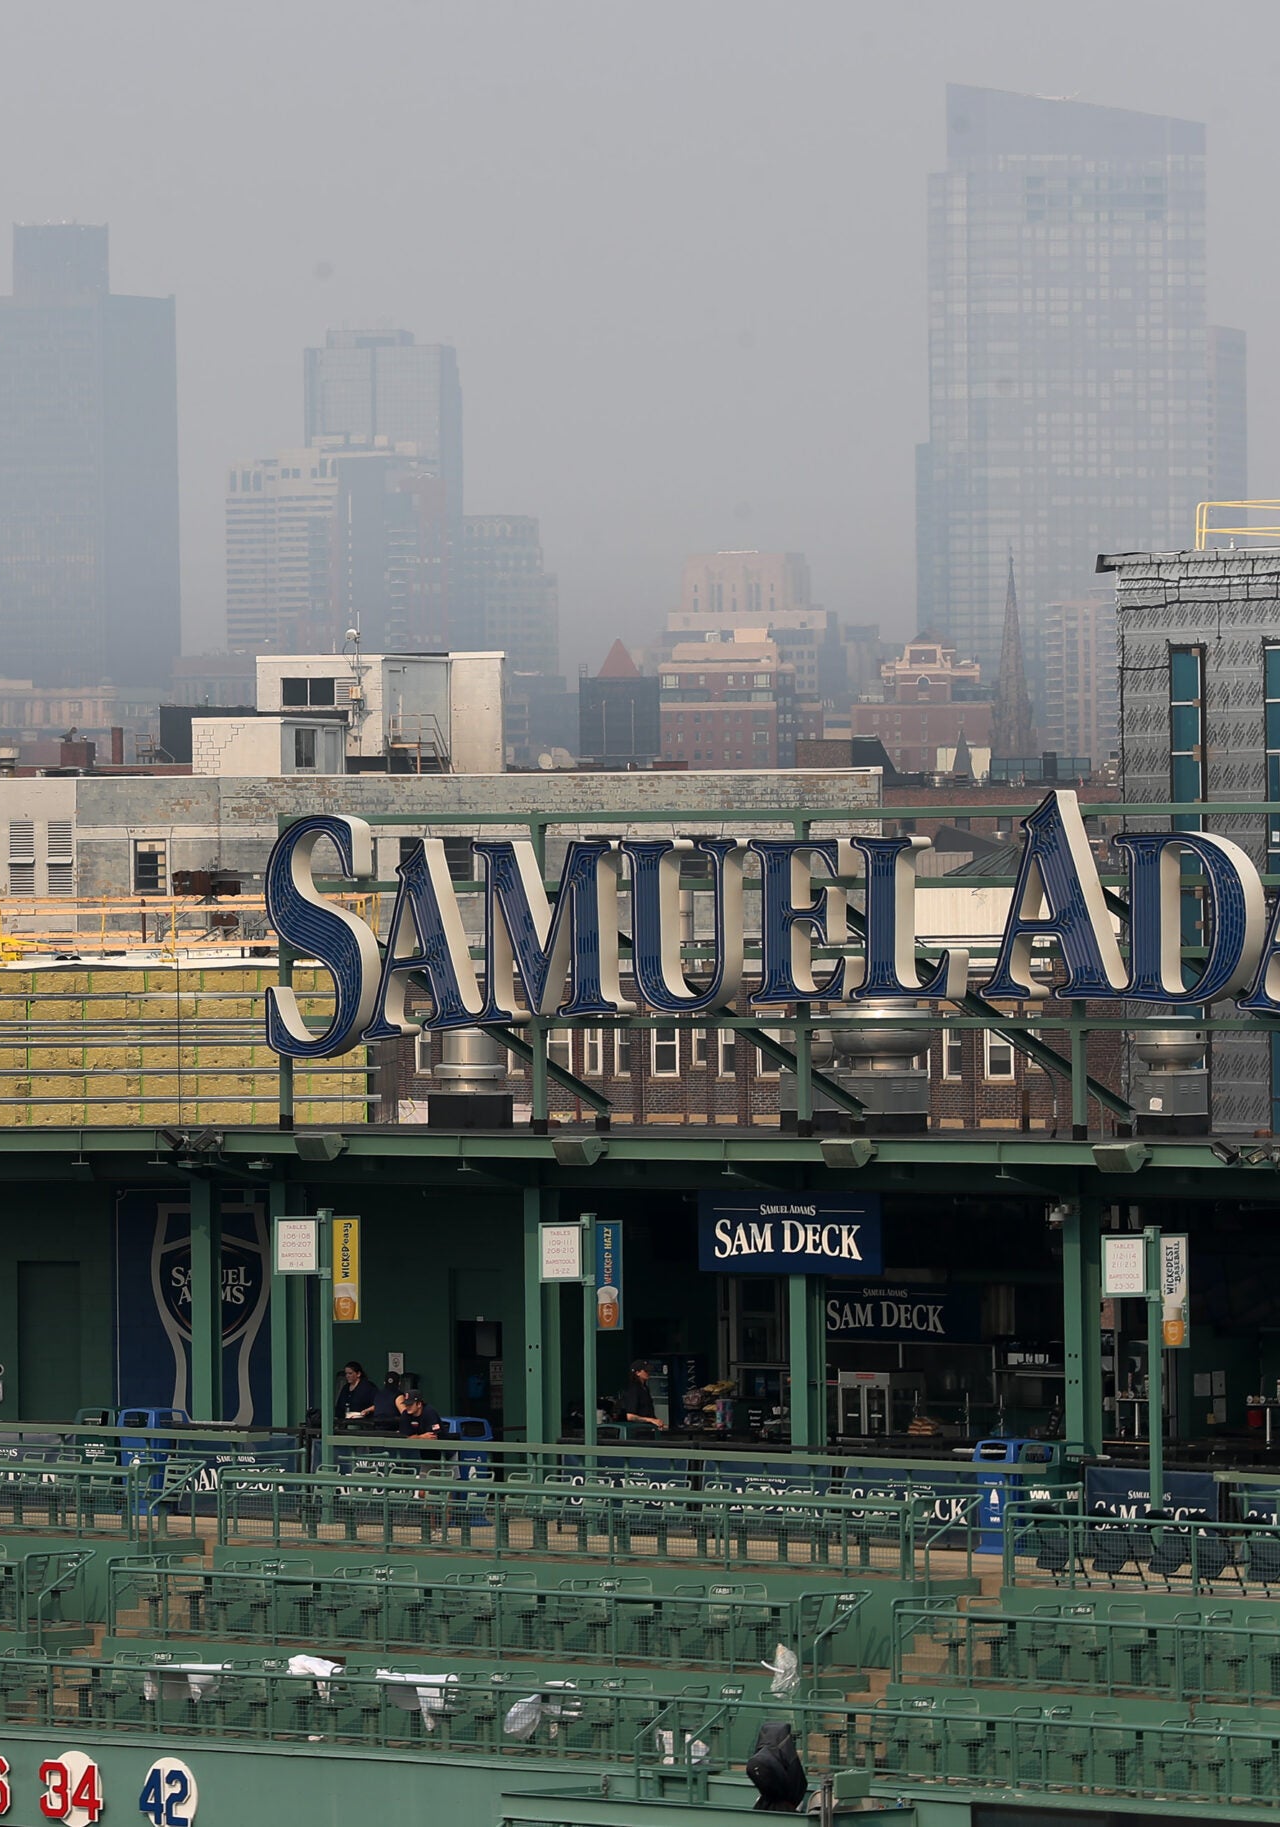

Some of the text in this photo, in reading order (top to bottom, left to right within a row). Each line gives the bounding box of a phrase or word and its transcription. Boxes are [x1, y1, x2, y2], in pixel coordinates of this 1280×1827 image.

[266, 814, 967, 1059] SAMUEL
[760, 1203, 817, 1217] SAMUEL ADAMS
[714, 1218, 863, 1261] SAM DECK
[172, 1266, 252, 1287] SAEL
[863, 1288, 908, 1298] SAMUEL ADAMS
[178, 1286, 246, 1305] AMS
[826, 1300, 946, 1334] SAM DECK
[39, 1759, 103, 1822] 34
[138, 1768, 194, 1827] 42
